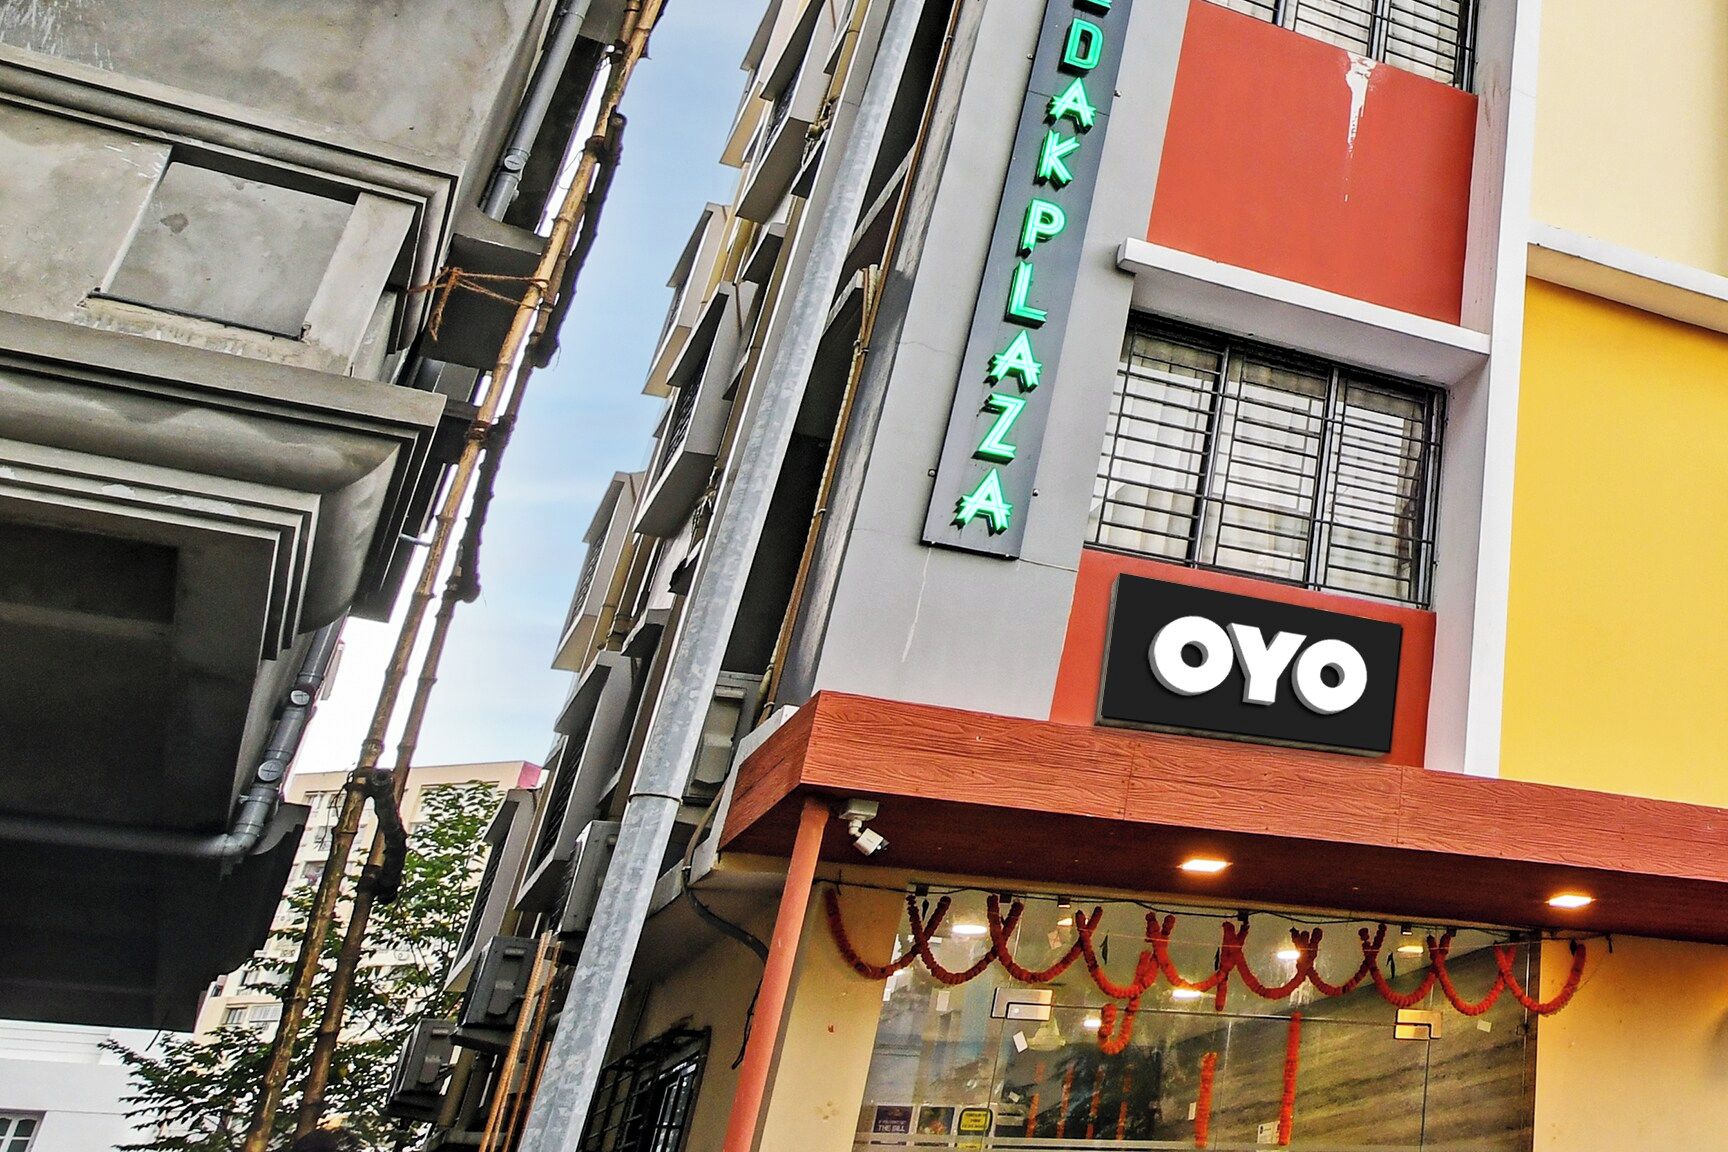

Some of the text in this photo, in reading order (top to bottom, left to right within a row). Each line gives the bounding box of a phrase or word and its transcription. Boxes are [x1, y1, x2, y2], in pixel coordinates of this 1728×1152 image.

[1035, 17, 1104, 189] DAK
[953, 198, 1067, 536] PLAZA
[1149, 615, 1368, 715] OYO
